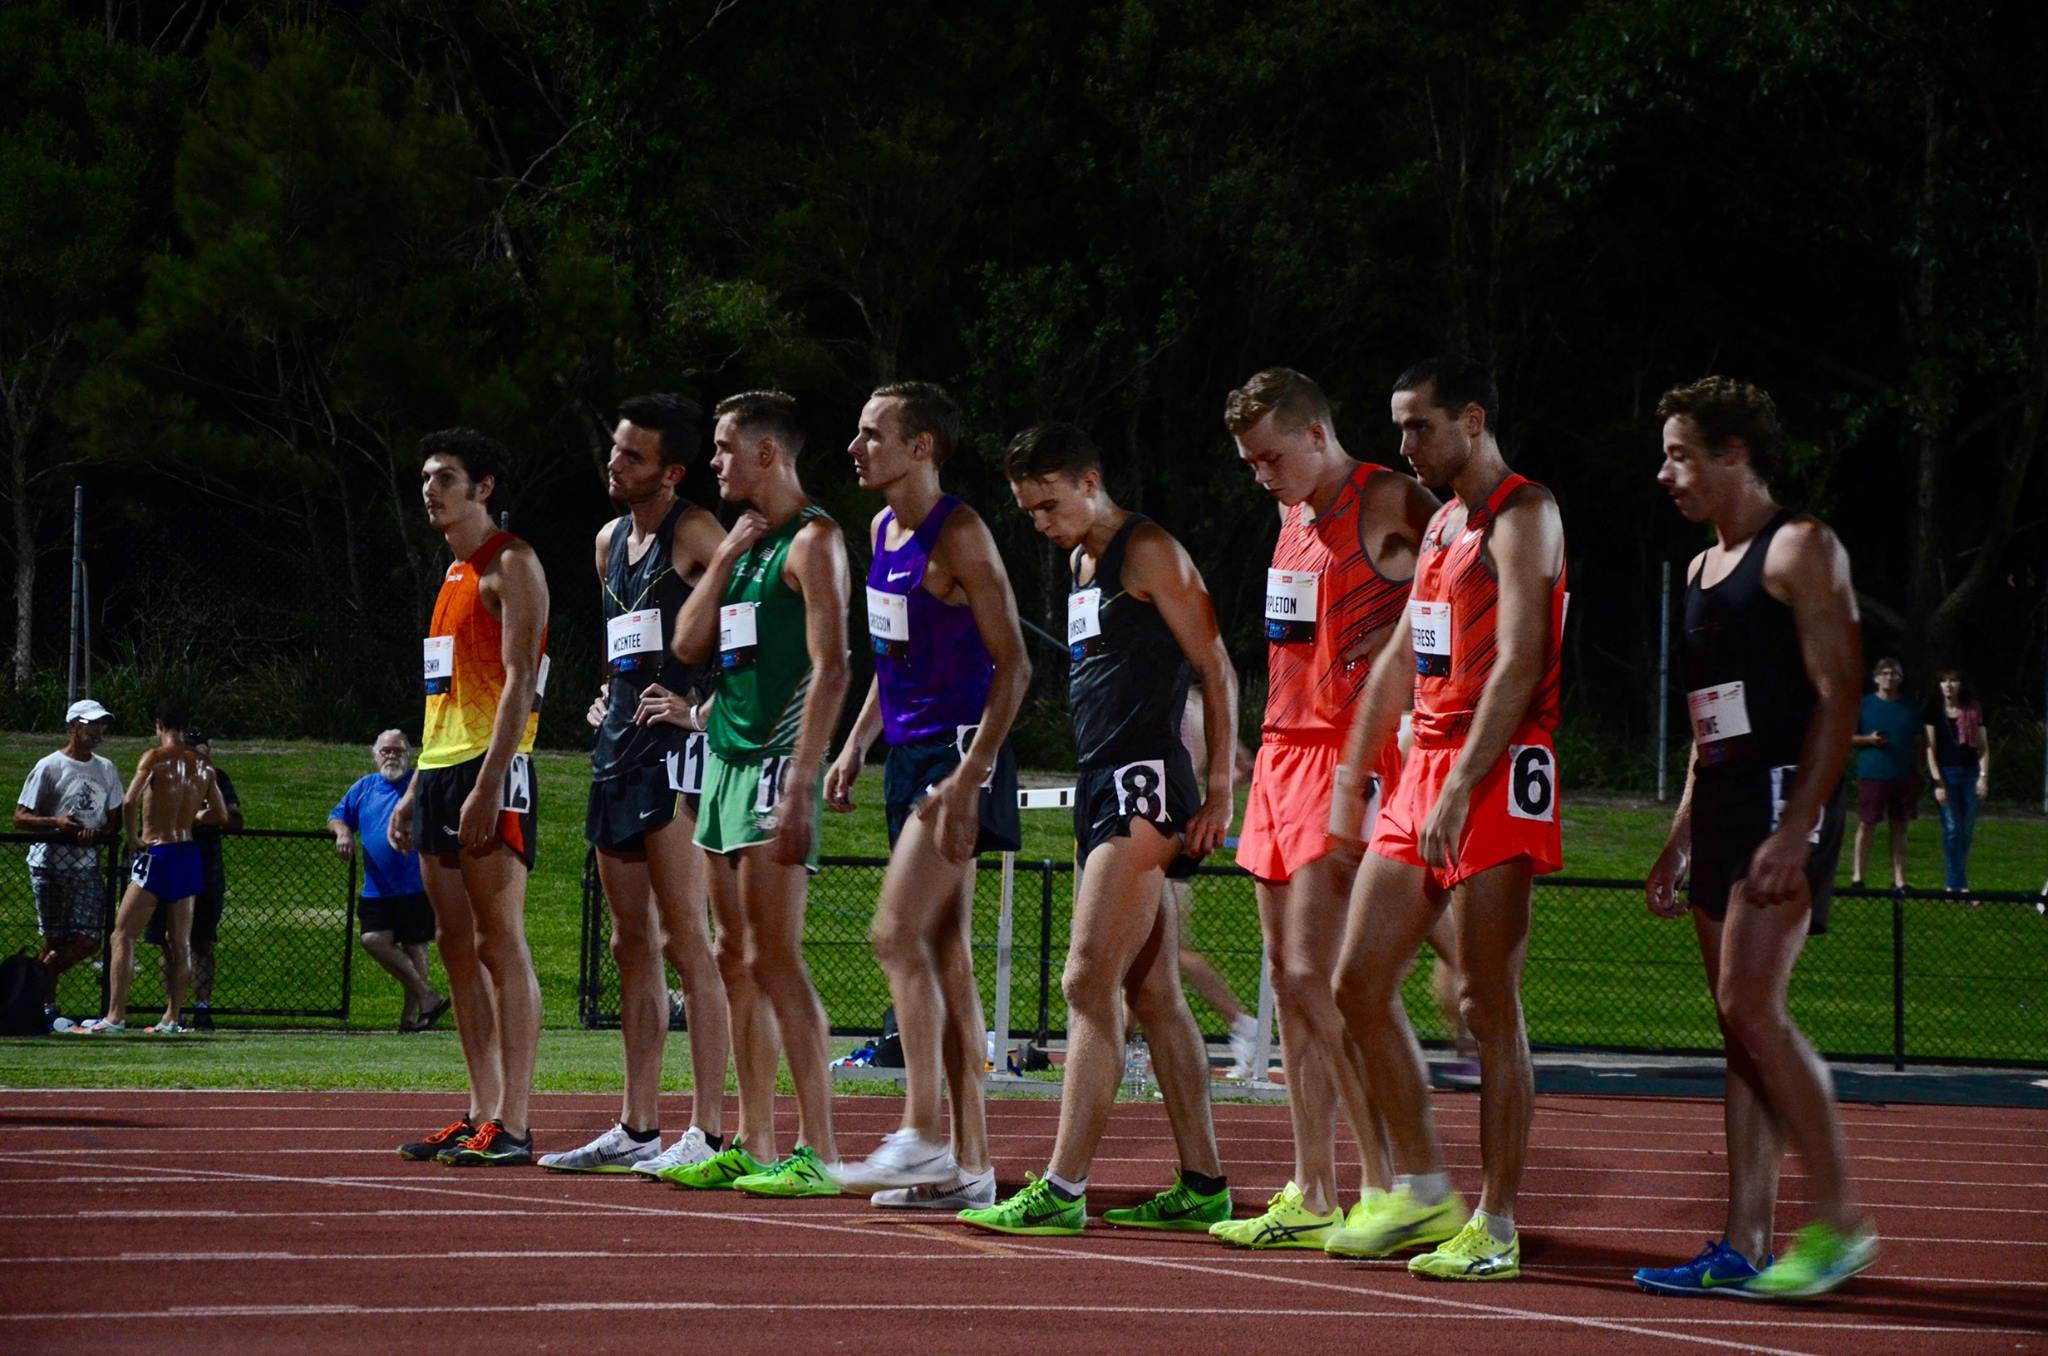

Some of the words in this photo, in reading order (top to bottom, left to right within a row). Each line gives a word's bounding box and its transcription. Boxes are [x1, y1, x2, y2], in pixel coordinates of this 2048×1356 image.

[613, 633, 641, 653] MCENTEE
[670, 735, 705, 790] 11
[1513, 747, 1552, 816] 6
[1121, 765, 1162, 821] 8
[133, 854, 150, 880] 4
